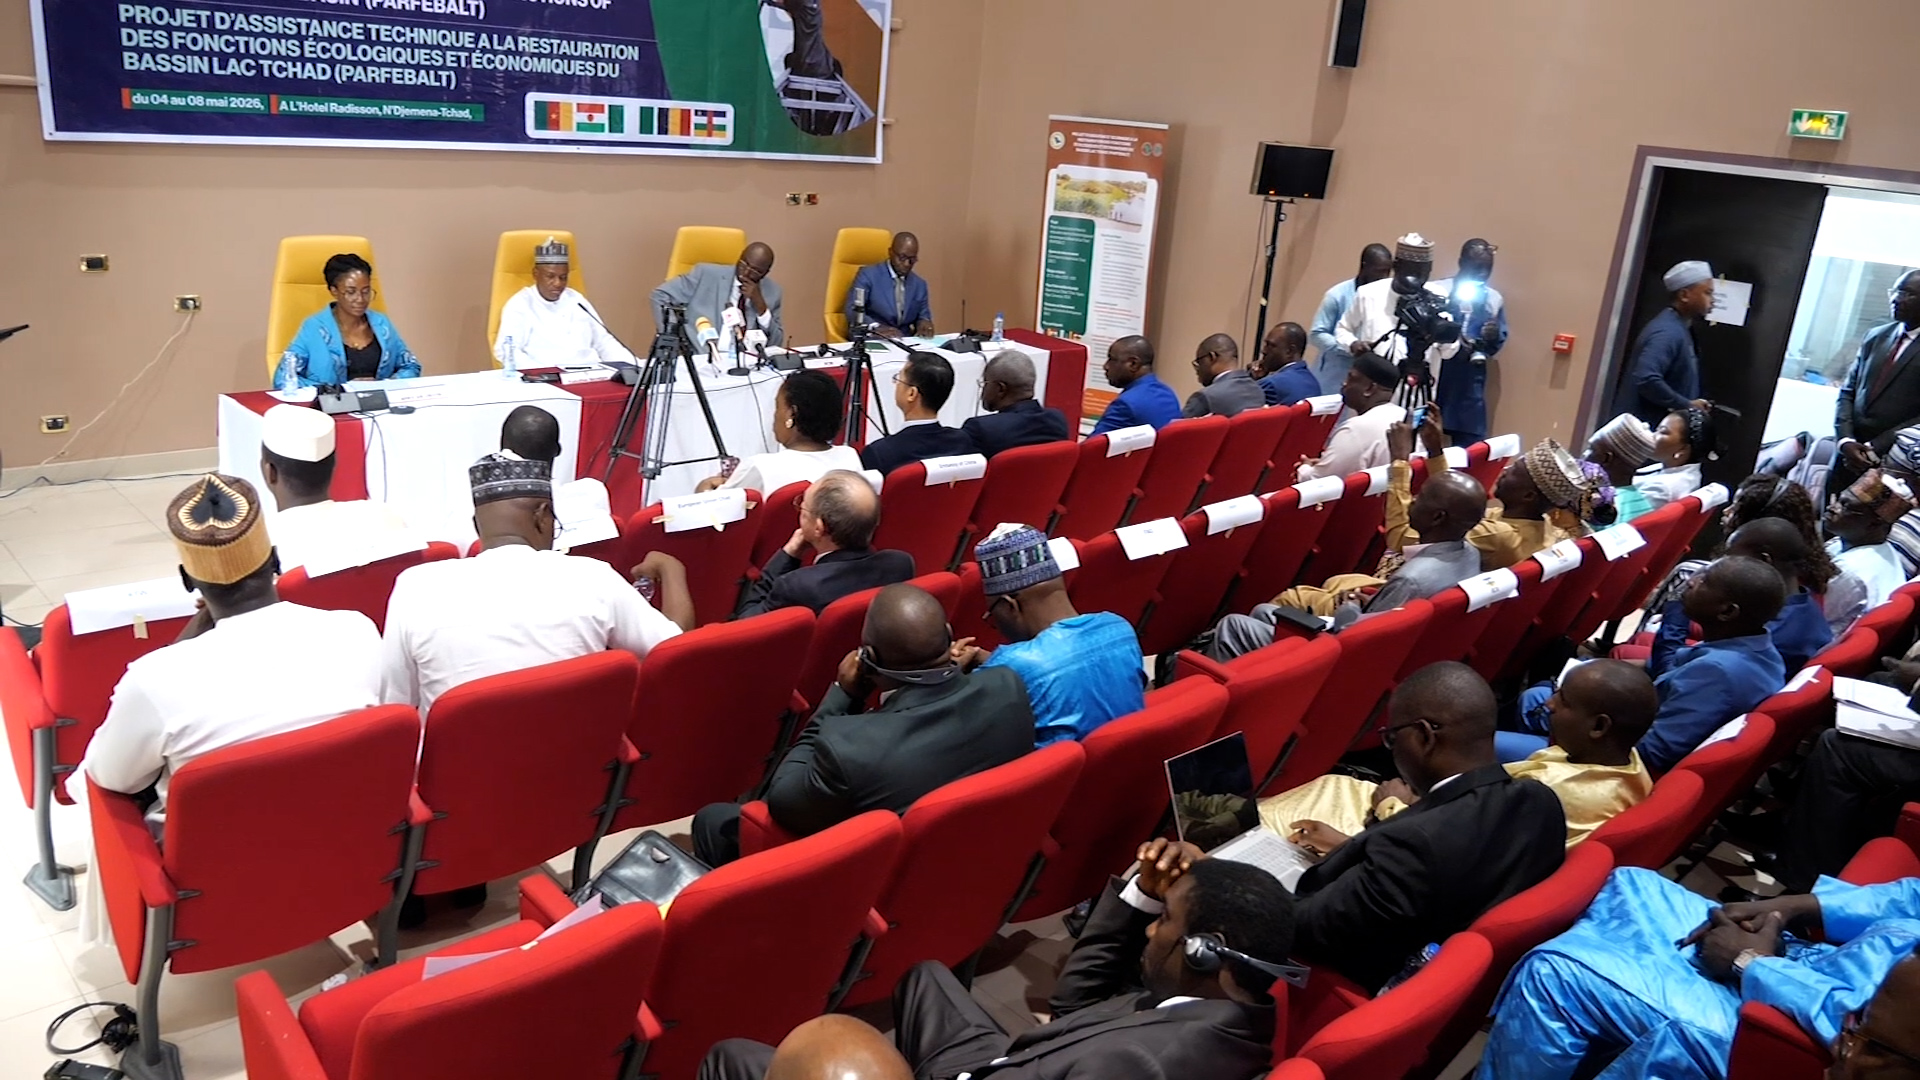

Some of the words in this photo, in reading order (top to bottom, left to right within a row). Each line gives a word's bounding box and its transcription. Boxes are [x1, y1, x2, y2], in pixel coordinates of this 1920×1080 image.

[118, 4, 211, 28] PROJET
[214, 11, 365, 40] D'ASSISTANCE
[366, 24, 476, 49] TECHNIQUE
[477, 33, 491, 49] A
[492, 34, 516, 51] LA
[517, 36, 639, 61] RESTAURATION
[120, 28, 170, 49] DES
[172, 31, 301, 57] FONCTIONS
[303, 38, 444, 66] ÉCOLOGIQUES
[446, 50, 469, 68] ET
[471, 50, 596, 77] ÉCONOMIQUES
[597, 62, 620, 78] DU
[122, 52, 209, 75] BASSIN
[212, 57, 257, 77] LAC
[258, 60, 332, 81] TCHAD
[334, 64, 457, 90] (PARFEBALT)
[132, 93, 149, 104] du
[150, 94, 169, 105] 04
[170, 96, 186, 106] au
[187, 95, 205, 107] 08
[206, 96, 228, 108] mai
[229, 97, 265, 110] 2026,
[279, 101, 289, 111] A
[330, 103, 382, 117] Radisson,
